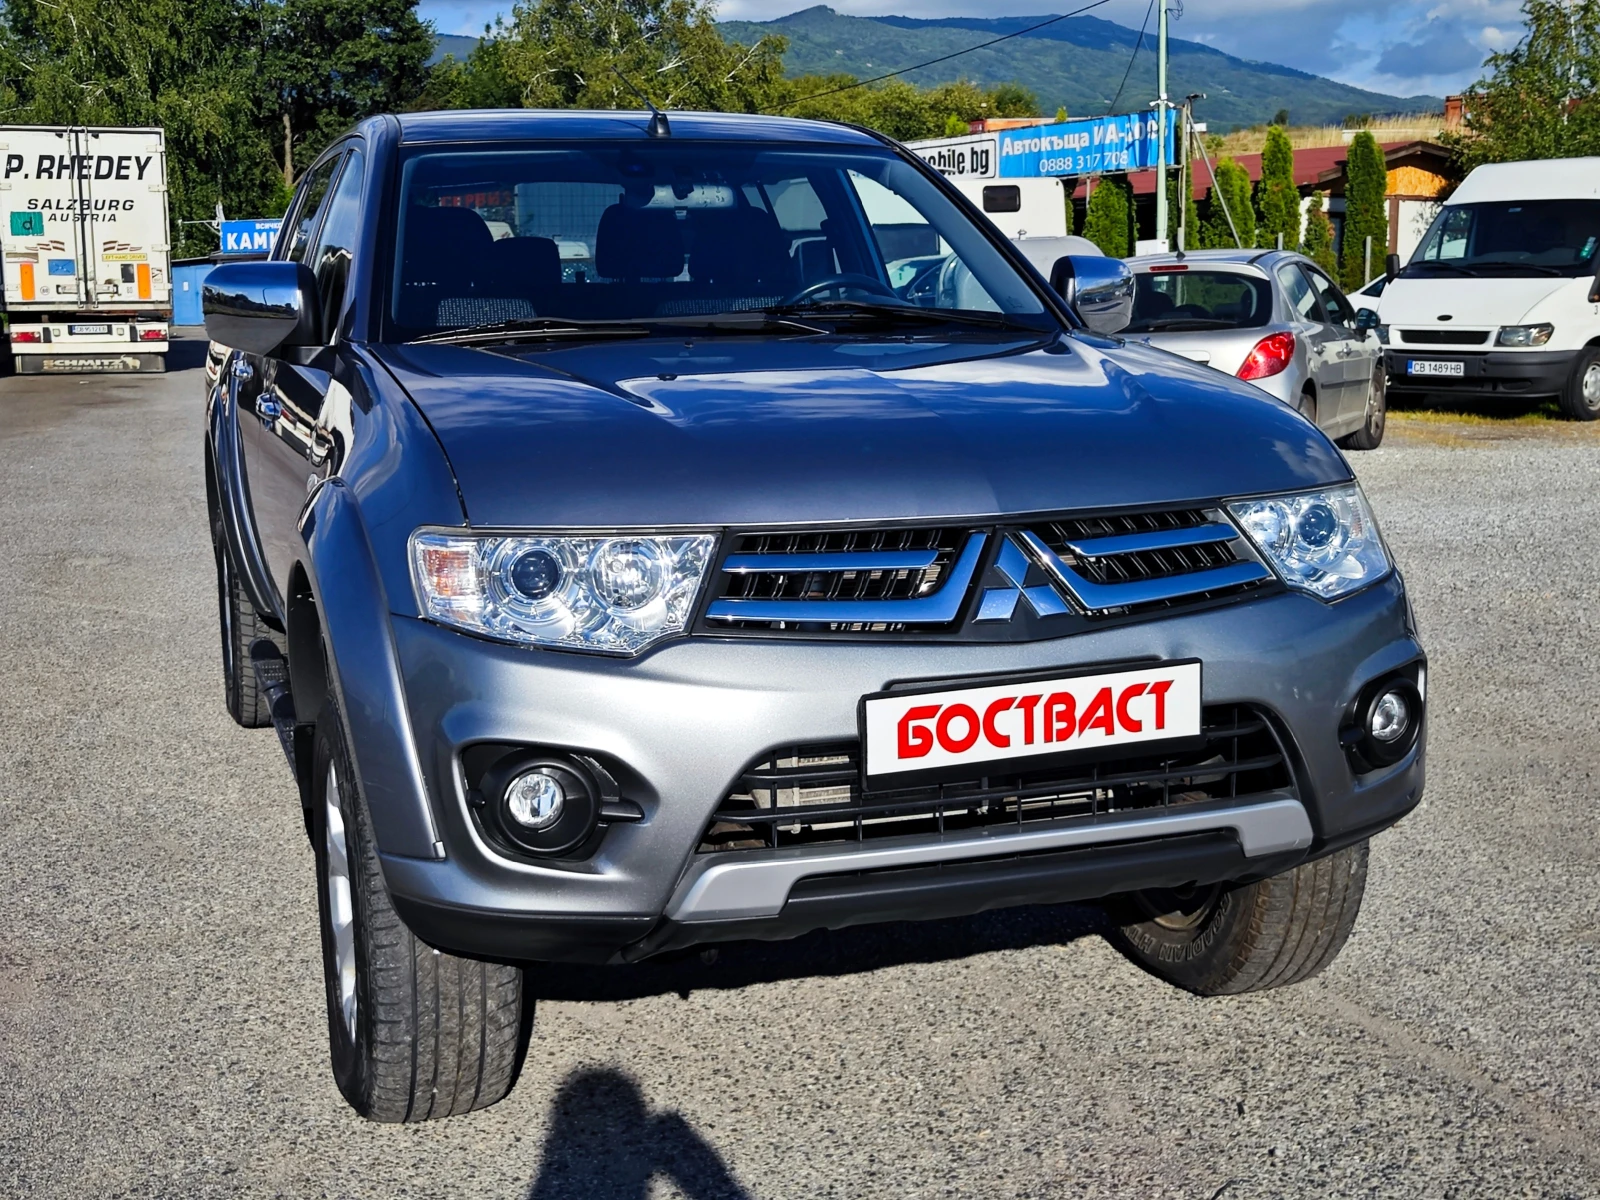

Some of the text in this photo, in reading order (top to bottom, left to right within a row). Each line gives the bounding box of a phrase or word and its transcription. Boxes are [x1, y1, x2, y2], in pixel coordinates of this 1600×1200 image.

[1002, 131, 1089, 157] Автокъща
[36, 154, 153, 180] RHEDEY
[1039, 150, 1128, 173] 0888 317 708
[27, 198, 135, 211] SALZBURG
[48, 213, 117, 223] AUSTRIA
[1413, 362, 1462, 374] CB 1489 HB
